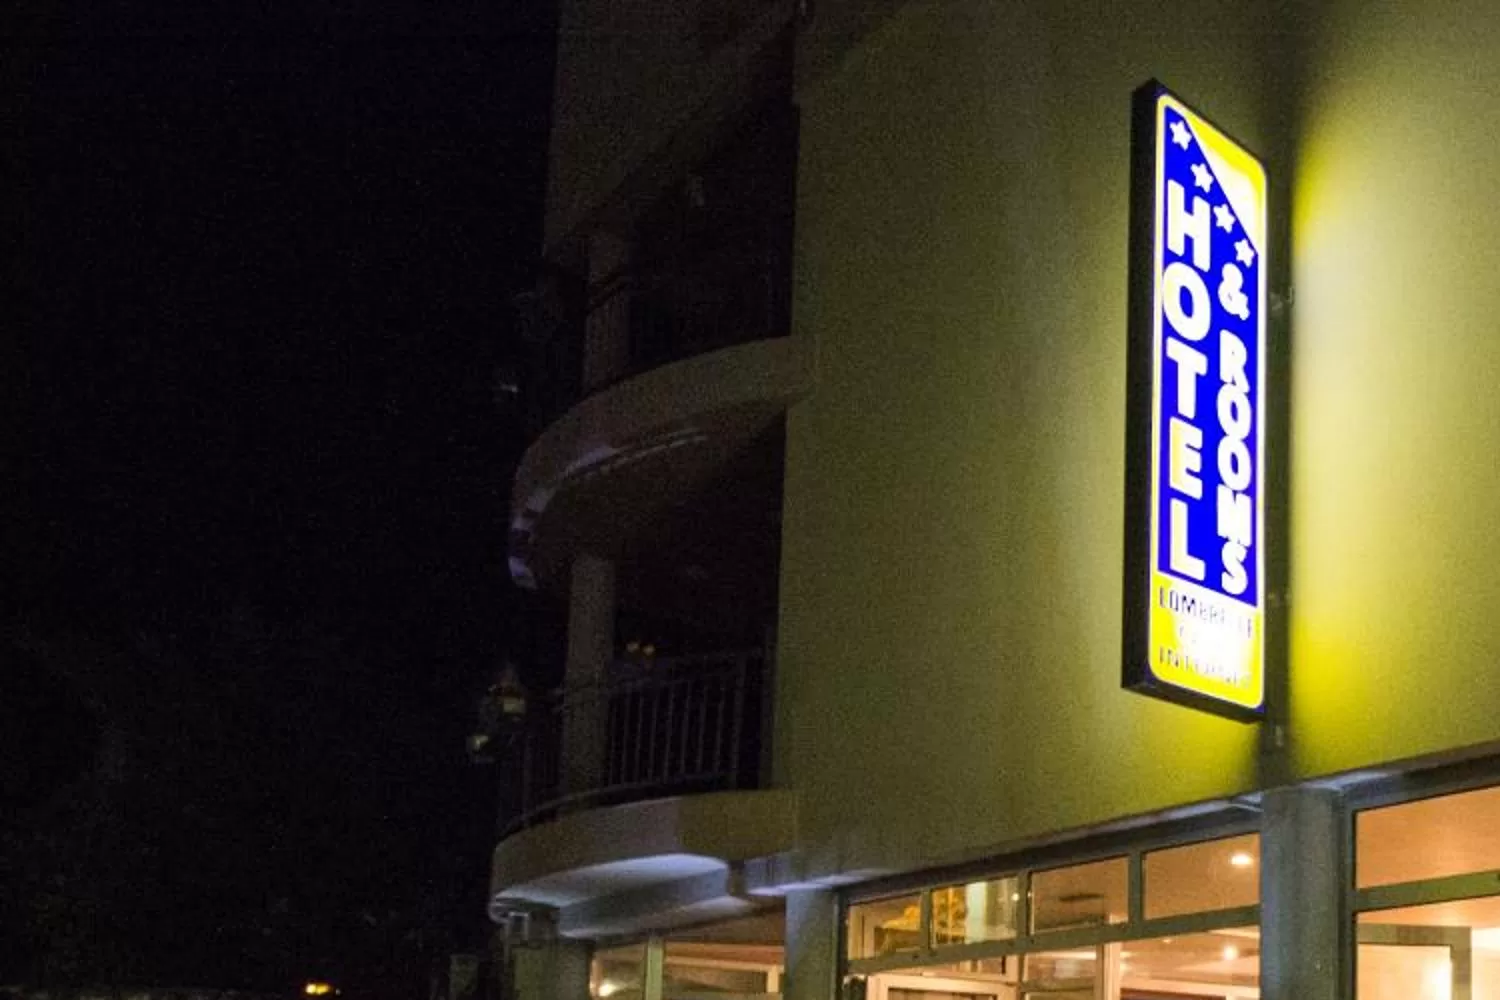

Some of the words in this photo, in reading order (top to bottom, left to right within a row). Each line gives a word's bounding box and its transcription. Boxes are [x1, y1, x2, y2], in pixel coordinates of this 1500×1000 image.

[1162, 178, 1212, 582] HOTEL
[1217, 262, 1250, 321] &
[1216, 328, 1252, 595] ROOMS
